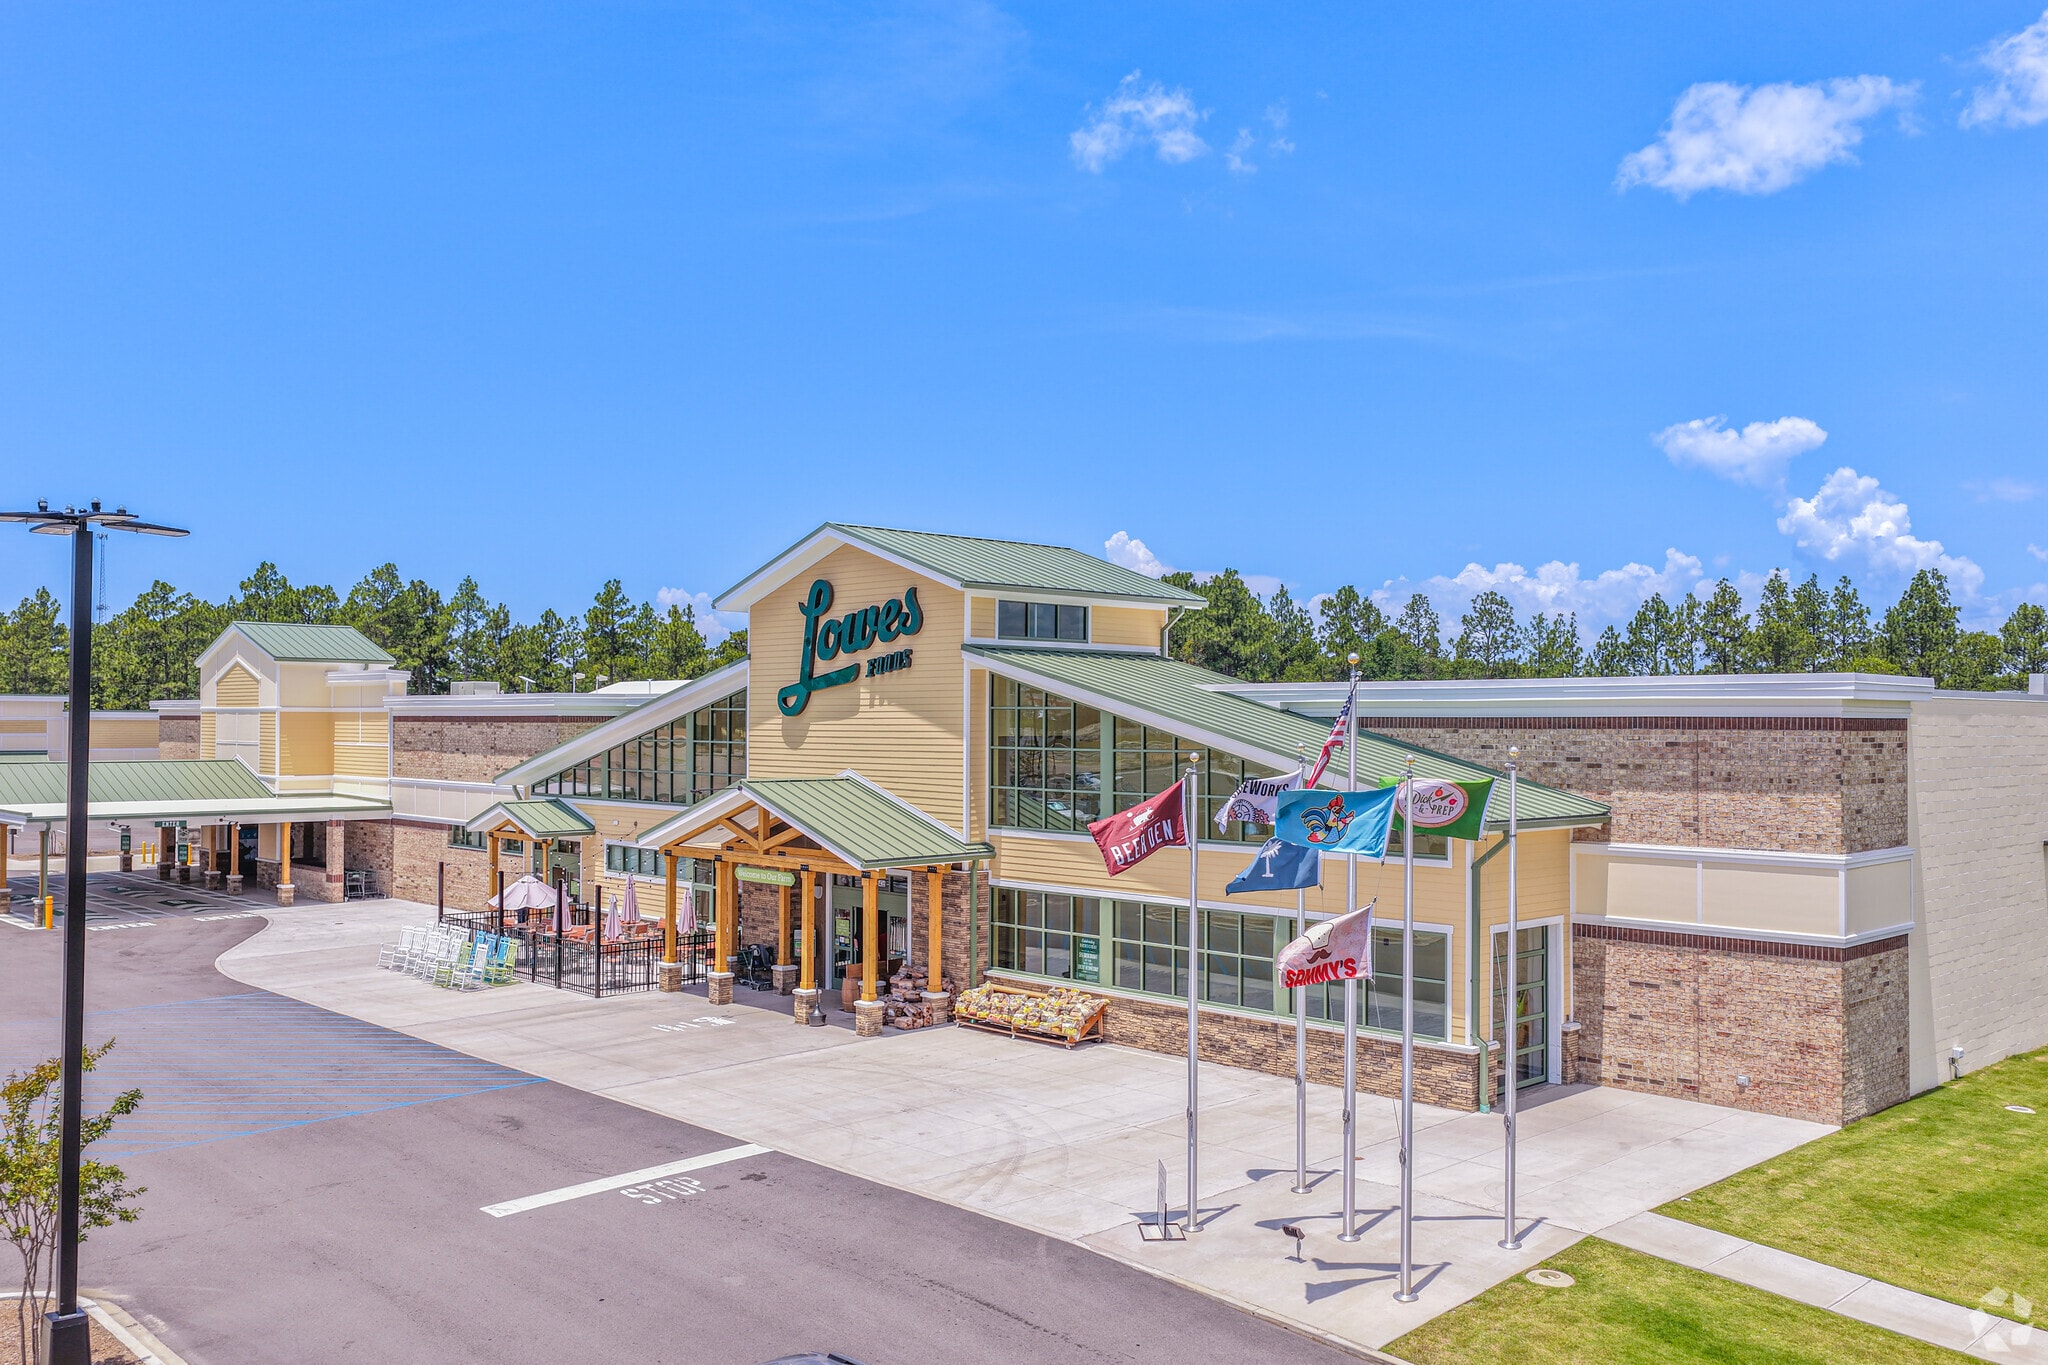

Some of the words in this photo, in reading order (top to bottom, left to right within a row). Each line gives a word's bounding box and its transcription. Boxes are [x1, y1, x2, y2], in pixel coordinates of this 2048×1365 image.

[777, 579, 924, 717] Lowes
[865, 648, 913, 678] FOODS
[1431, 804, 1455, 816] PREP
[1110, 832, 1148, 866] BEER
[1147, 819, 1174, 849] DEN
[738, 869, 760, 879] Welcome
[767, 872, 777, 881] Our
[777, 873, 792, 883] Farm
[1285, 957, 1357, 989] SAMMY'S
[620, 1177, 706, 1204] STOP
